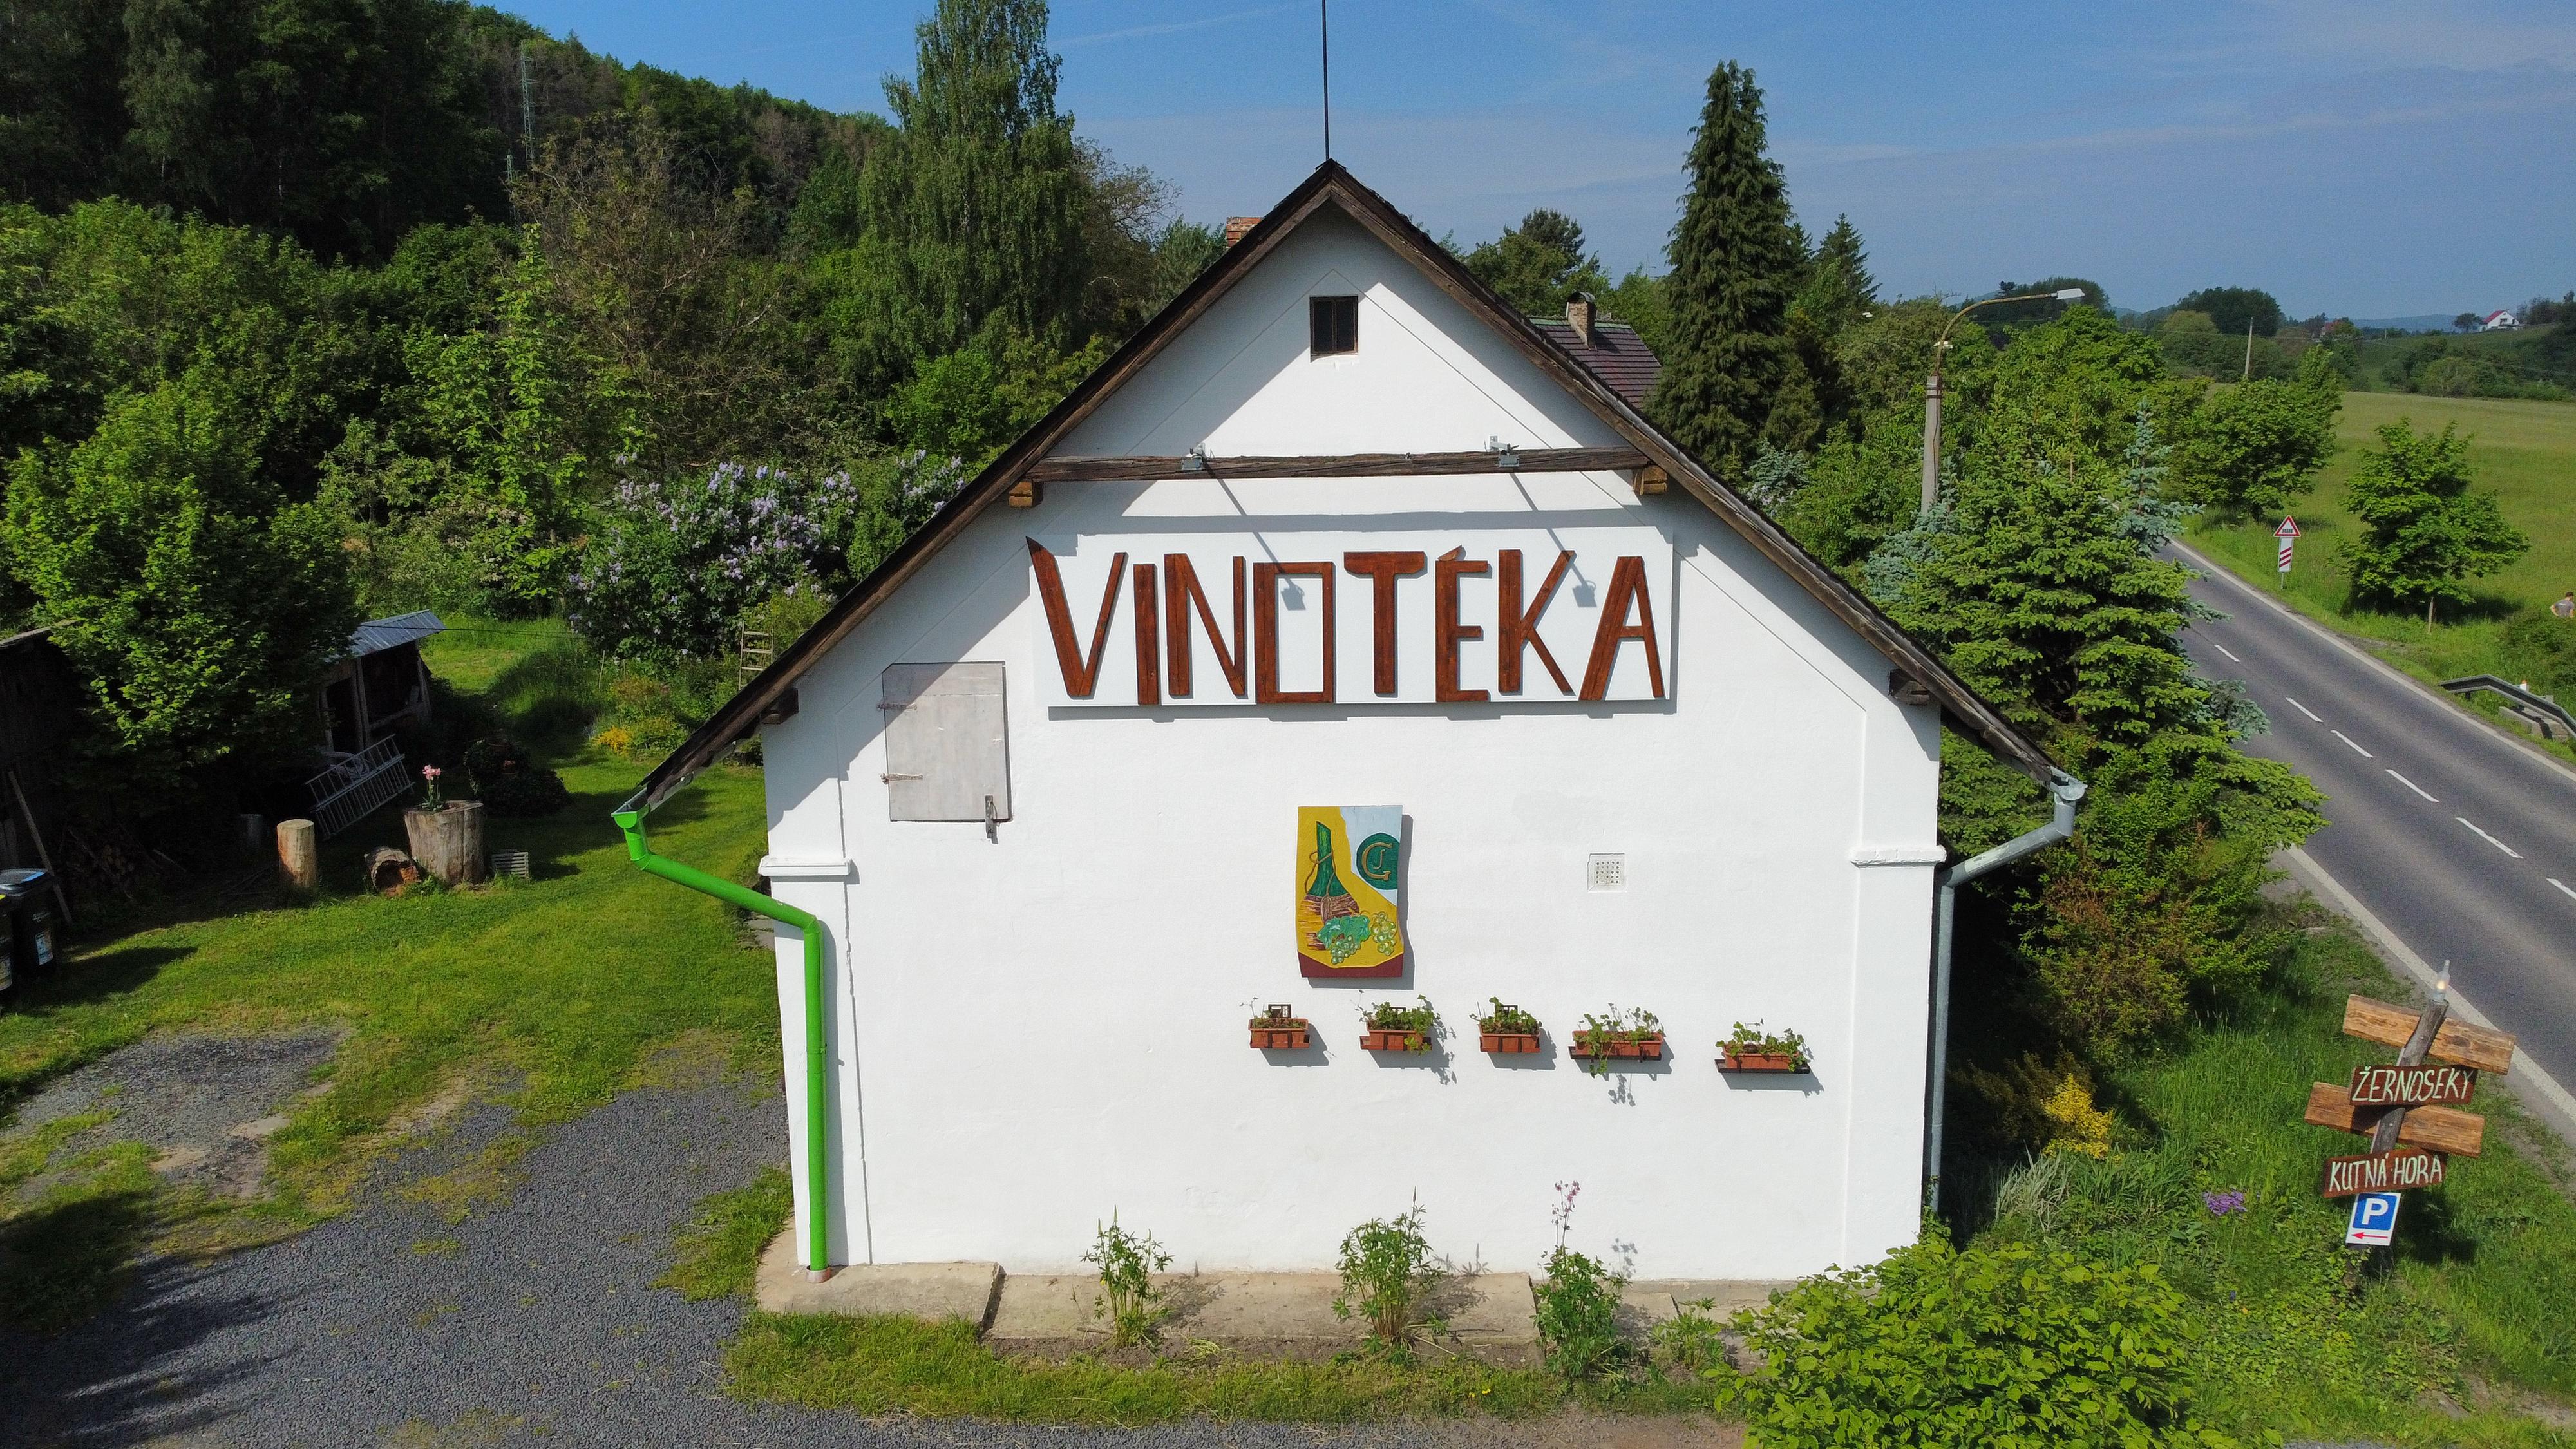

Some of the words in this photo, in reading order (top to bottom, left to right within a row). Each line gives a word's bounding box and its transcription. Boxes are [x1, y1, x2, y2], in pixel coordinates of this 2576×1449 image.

[1026, 536, 1664, 705] VINOTÉKA
[2353, 1066, 2474, 1102] ŽERNOSEKY
[2329, 1153, 2389, 1192] KUTNÁ
[2394, 1155, 2443, 1186] HORA
[2362, 1199, 2389, 1224] P
